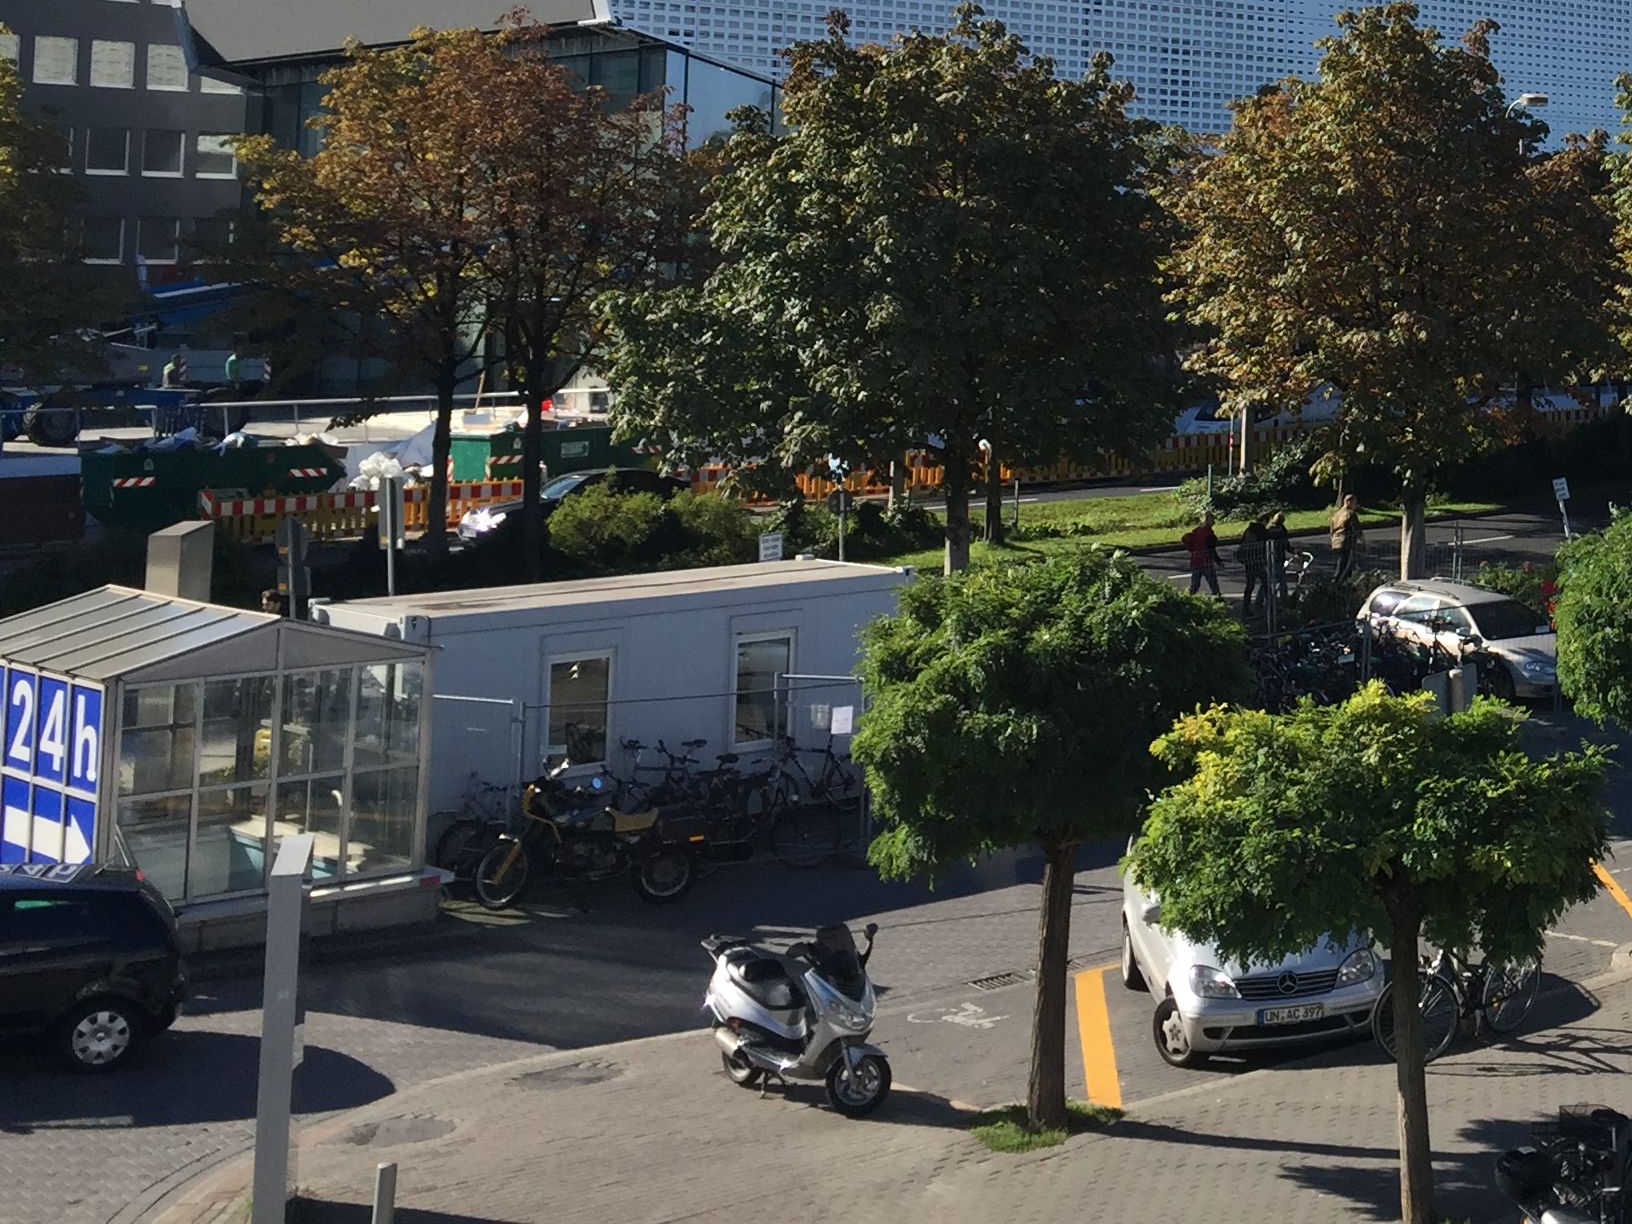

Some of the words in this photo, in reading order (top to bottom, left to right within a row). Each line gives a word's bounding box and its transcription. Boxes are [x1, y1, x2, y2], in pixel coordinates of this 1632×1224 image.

[9, 679, 97, 782] 24h
[1265, 1010, 1279, 1022] UN
[1286, 1008, 1300, 1020] AC
[1302, 1005, 1322, 1018] 397
